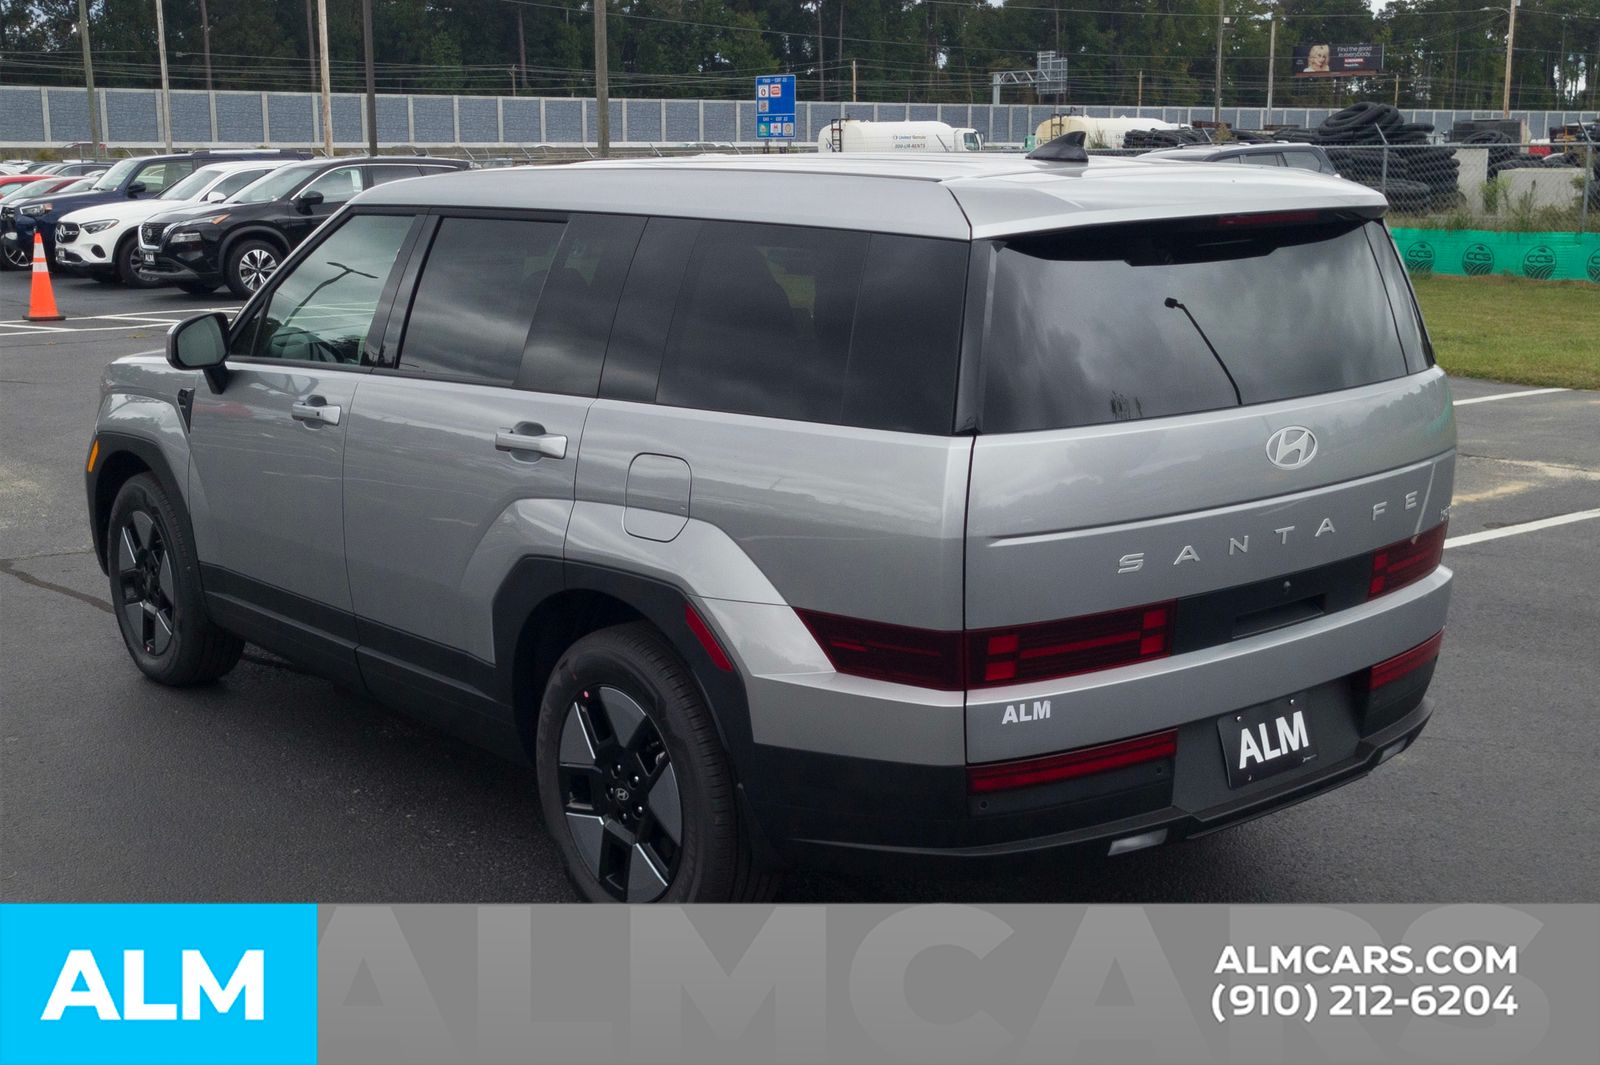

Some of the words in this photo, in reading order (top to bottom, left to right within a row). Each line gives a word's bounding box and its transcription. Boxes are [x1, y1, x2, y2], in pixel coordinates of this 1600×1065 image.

[1408, 250, 1433, 259] CCS
[1466, 252, 1491, 262] CCS
[1527, 254, 1554, 264] CCS
[1117, 516, 1336, 574] SANTA
[1372, 490, 1418, 521] FE
[1002, 700, 1050, 724] ALM
[1239, 711, 1310, 770] ALM
